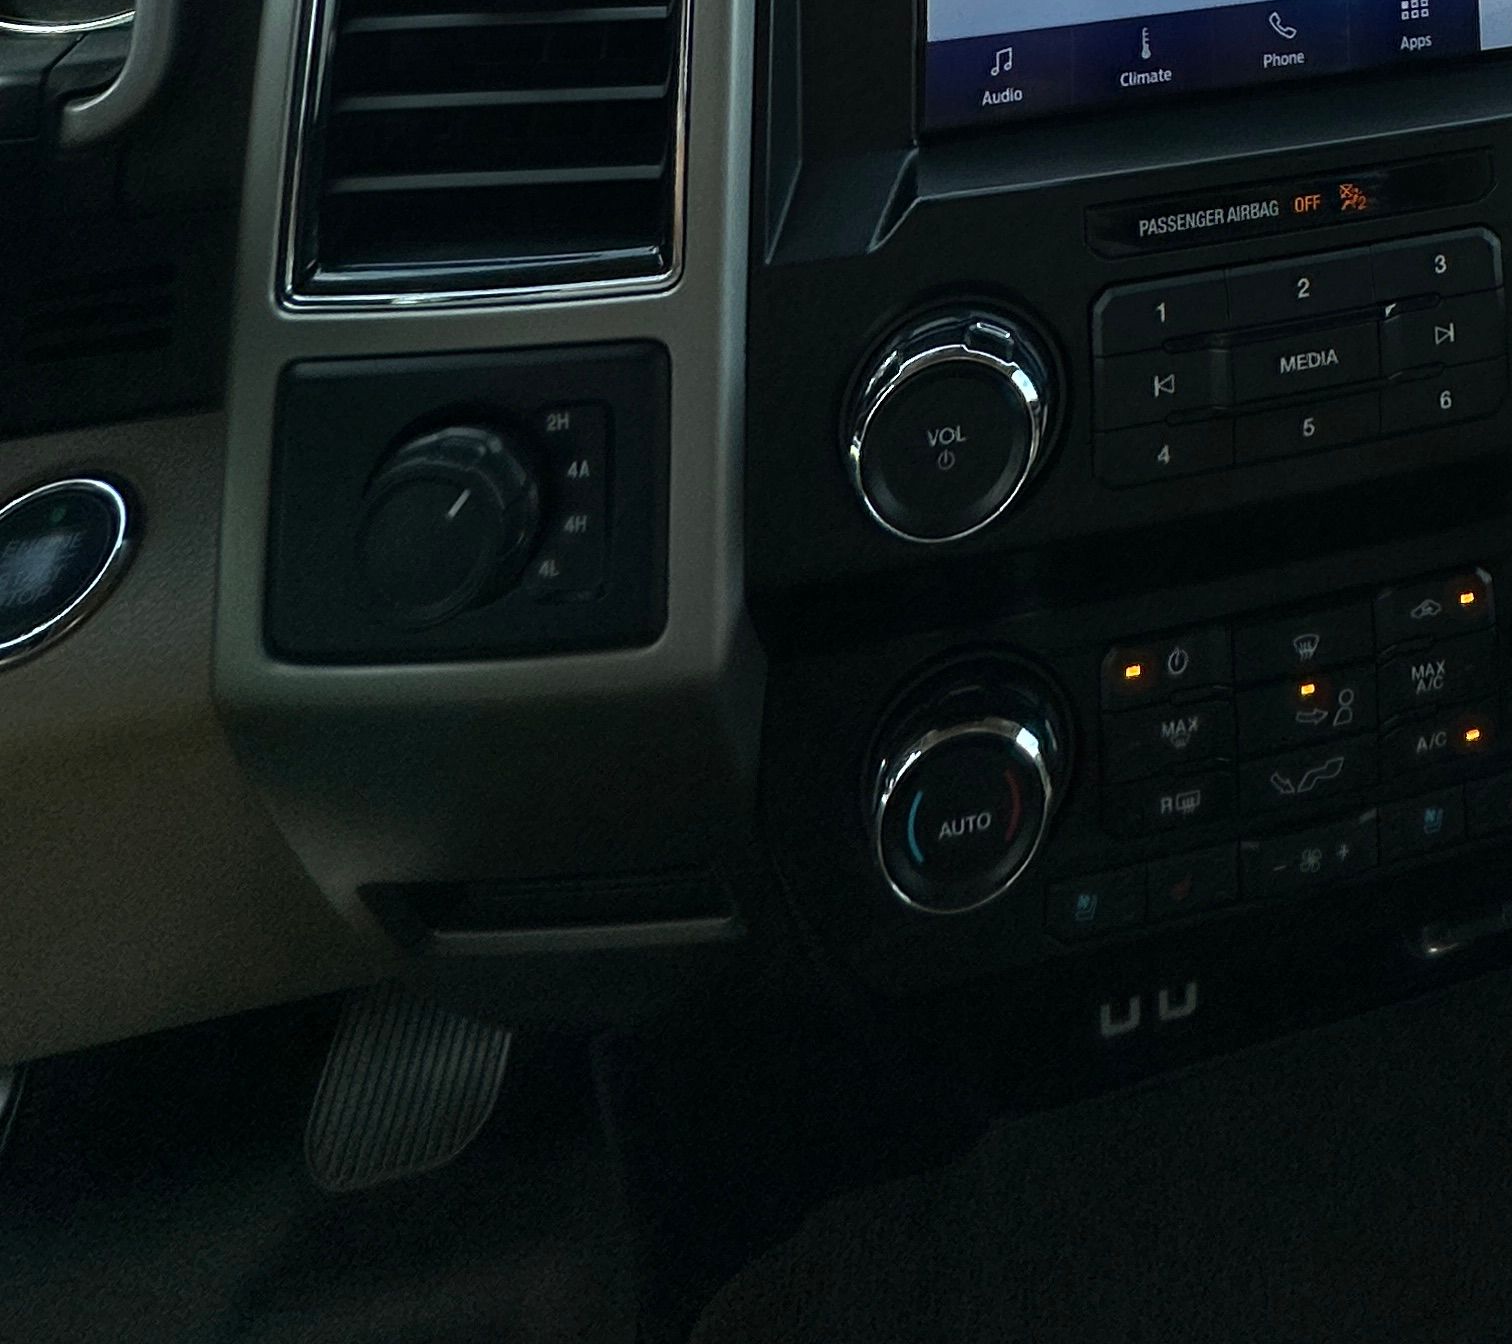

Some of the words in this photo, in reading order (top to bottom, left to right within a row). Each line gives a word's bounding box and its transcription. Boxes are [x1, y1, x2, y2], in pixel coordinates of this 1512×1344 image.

[1400, 34, 1432, 53] Apps
[1263, 50, 1305, 69] Phone
[1119, 68, 1173, 87] Climate
[981, 87, 1023, 106] Audio
[1139, 208, 1225, 237] PASSENGER
[1226, 199, 1280, 223] AIRBAG
[1294, 194, 1321, 213] OFF
[1434, 254, 1447, 274] 3
[1297, 277, 1310, 299] 2
[1157, 302, 1166, 323] 1
[1280, 348, 1339, 374] MEDIA
[1439, 390, 1452, 410] 6
[546, 412, 570, 432] 2H
[1303, 417, 1316, 437] 5
[927, 425, 966, 447] VOL
[1157, 444, 1171, 464] 4
[567, 459, 590, 478] 4A
[563, 514, 588, 533] 4H
[538, 559, 560, 577] 4L
[1411, 660, 1446, 679] MAX
[1415, 675, 1446, 696] A/C
[1161, 716, 1199, 739] MAX
[1416, 731, 1447, 753] A/C
[938, 812, 992, 840] AUTO
